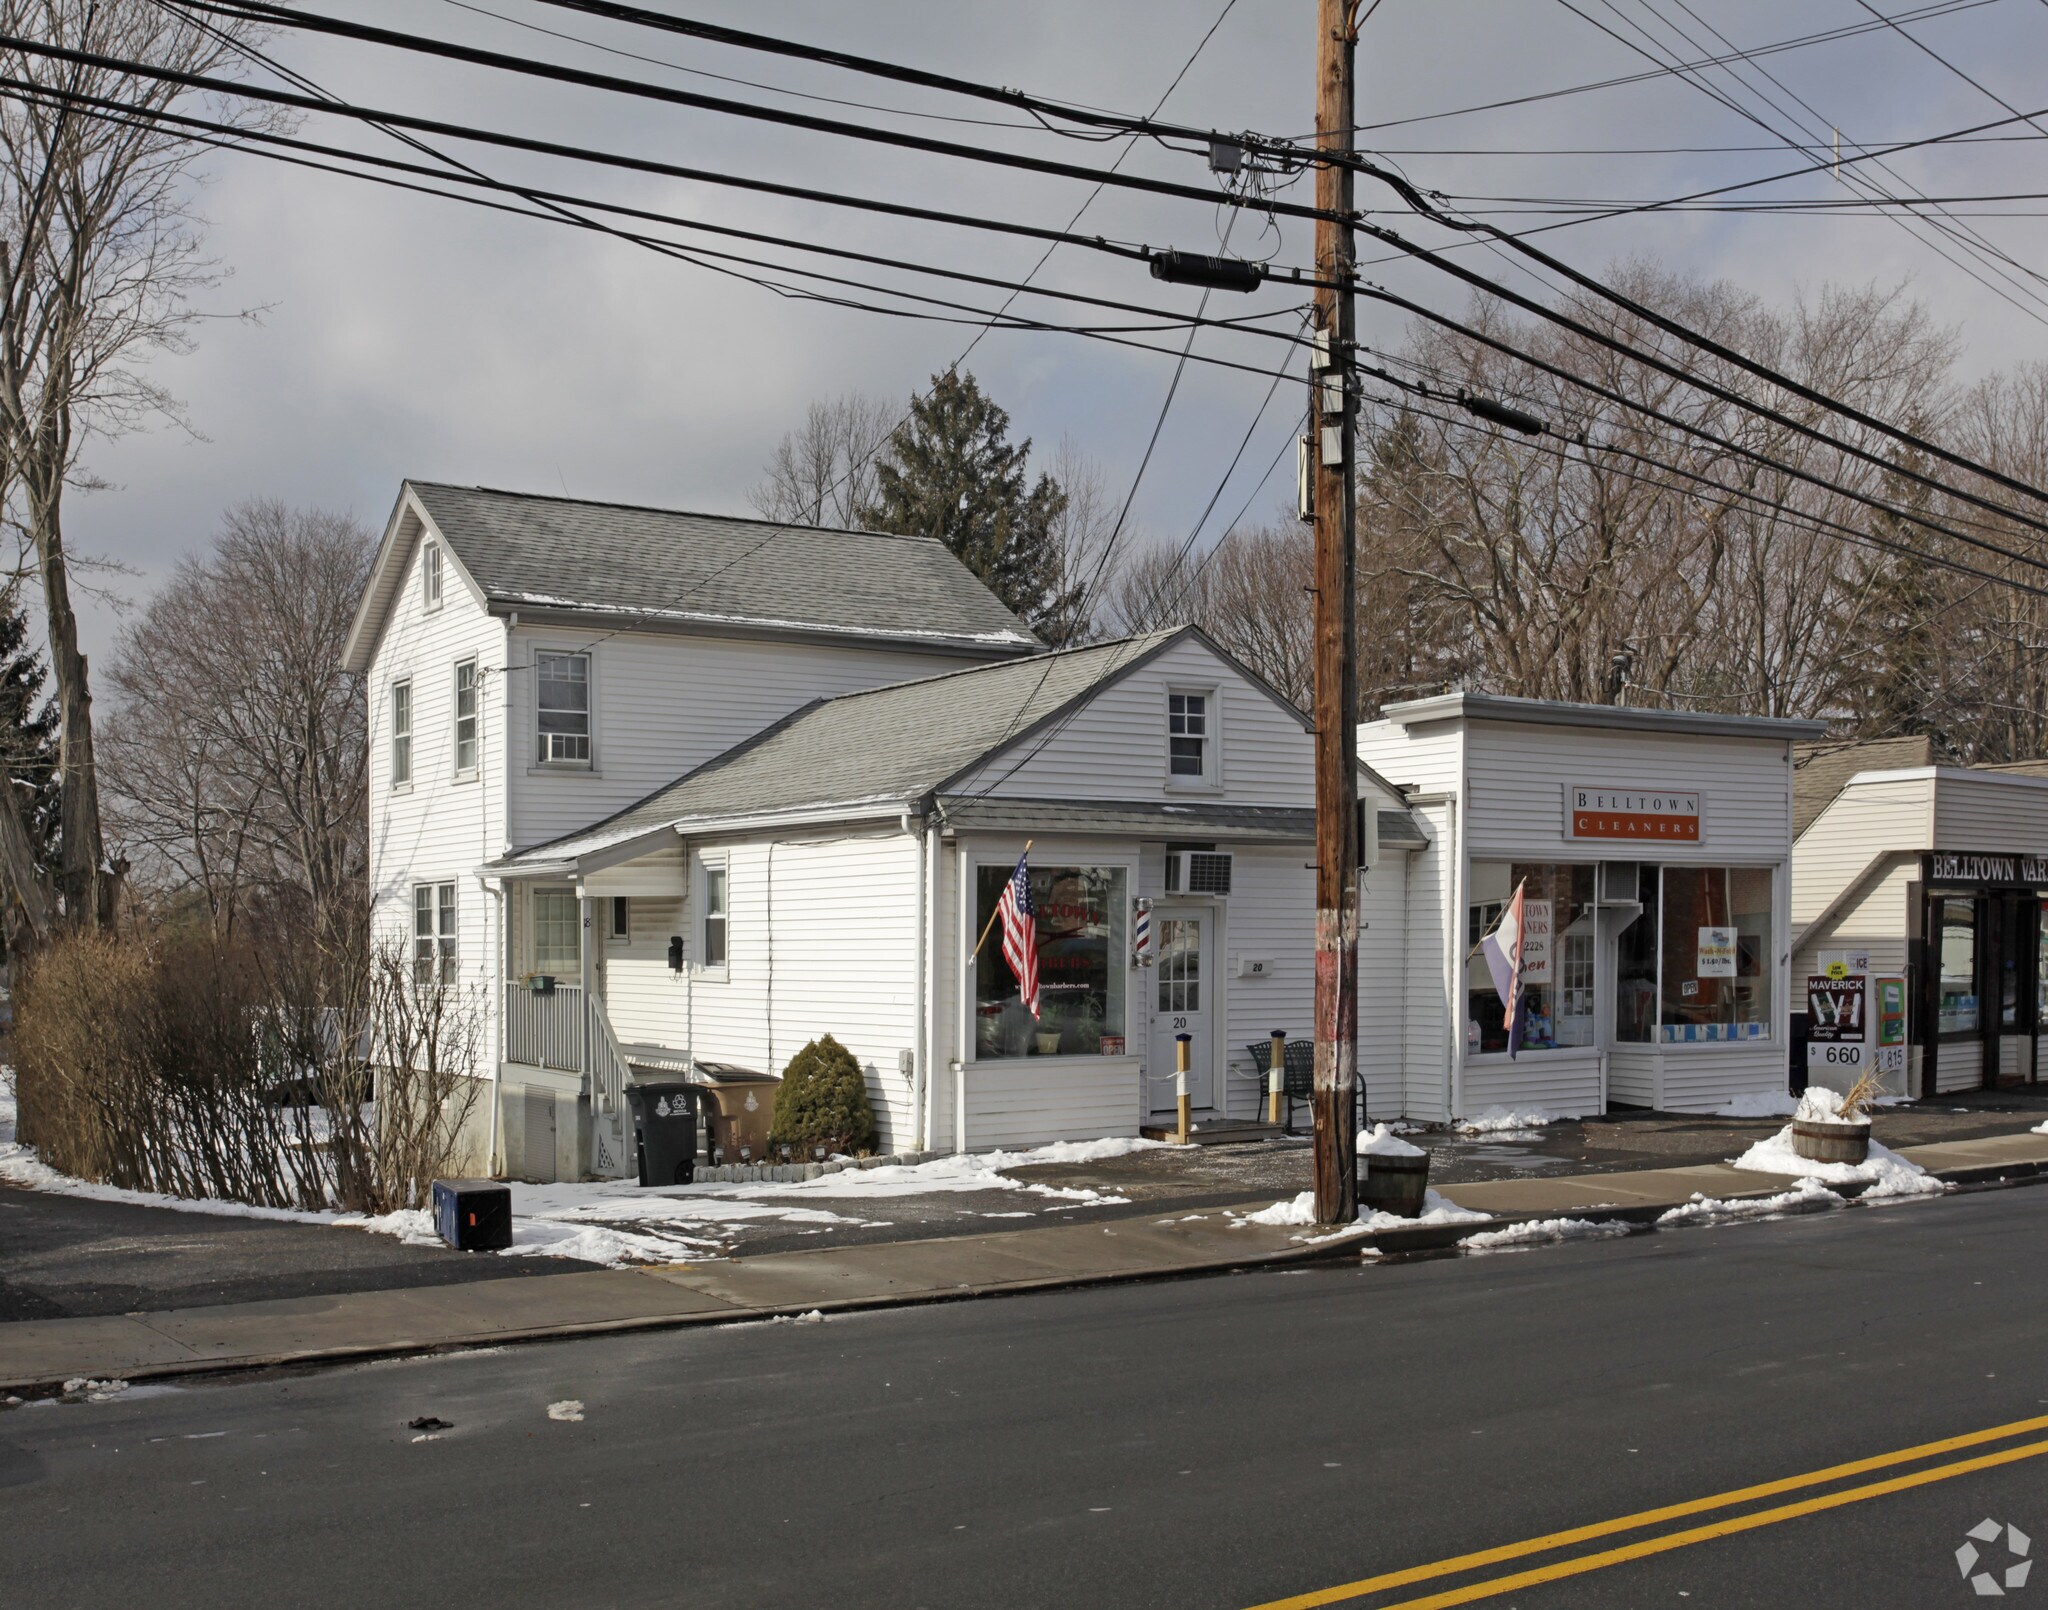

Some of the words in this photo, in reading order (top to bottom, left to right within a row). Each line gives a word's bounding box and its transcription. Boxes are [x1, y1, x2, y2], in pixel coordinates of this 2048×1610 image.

[1578, 792, 1695, 812] BELLTOWN
[1578, 817, 1695, 834] CLEANERS
[1932, 855, 2015, 881] BELLTOWN
[1252, 963, 1263, 972] 20
[1856, 958, 1867, 968] ICE
[1683, 983, 1698, 995] OPEN
[1809, 980, 1864, 990] MAVERICK
[1173, 1017, 1187, 1029] 20
[1811, 1046, 1816, 1056] $
